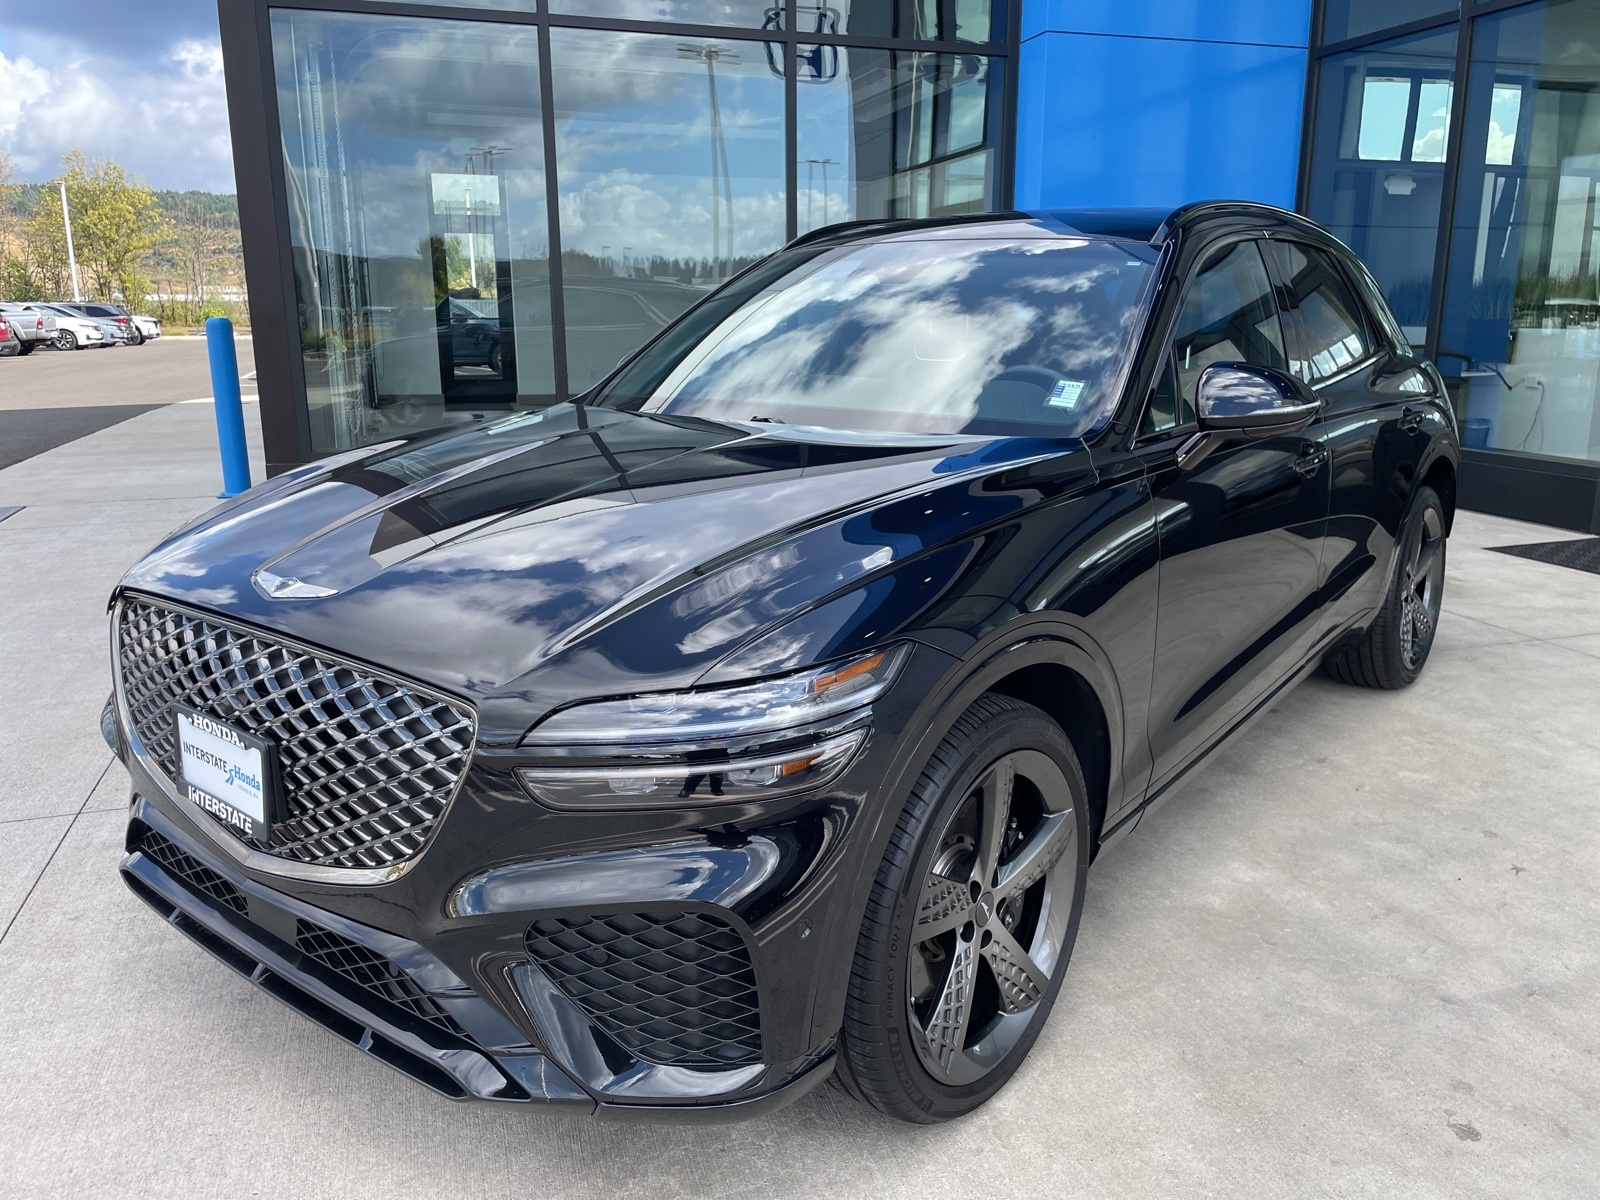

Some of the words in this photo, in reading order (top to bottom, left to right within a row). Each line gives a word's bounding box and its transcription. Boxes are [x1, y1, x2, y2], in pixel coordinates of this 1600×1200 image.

[192, 714, 240, 746] HONDA
[183, 741, 228, 773] INTERSTATE
[233, 764, 261, 792] Honda
[188, 785, 253, 835] INTERSTATE
[886, 965, 895, 1019] PRIMACY
[889, 1032, 923, 1102] MICHELIN
